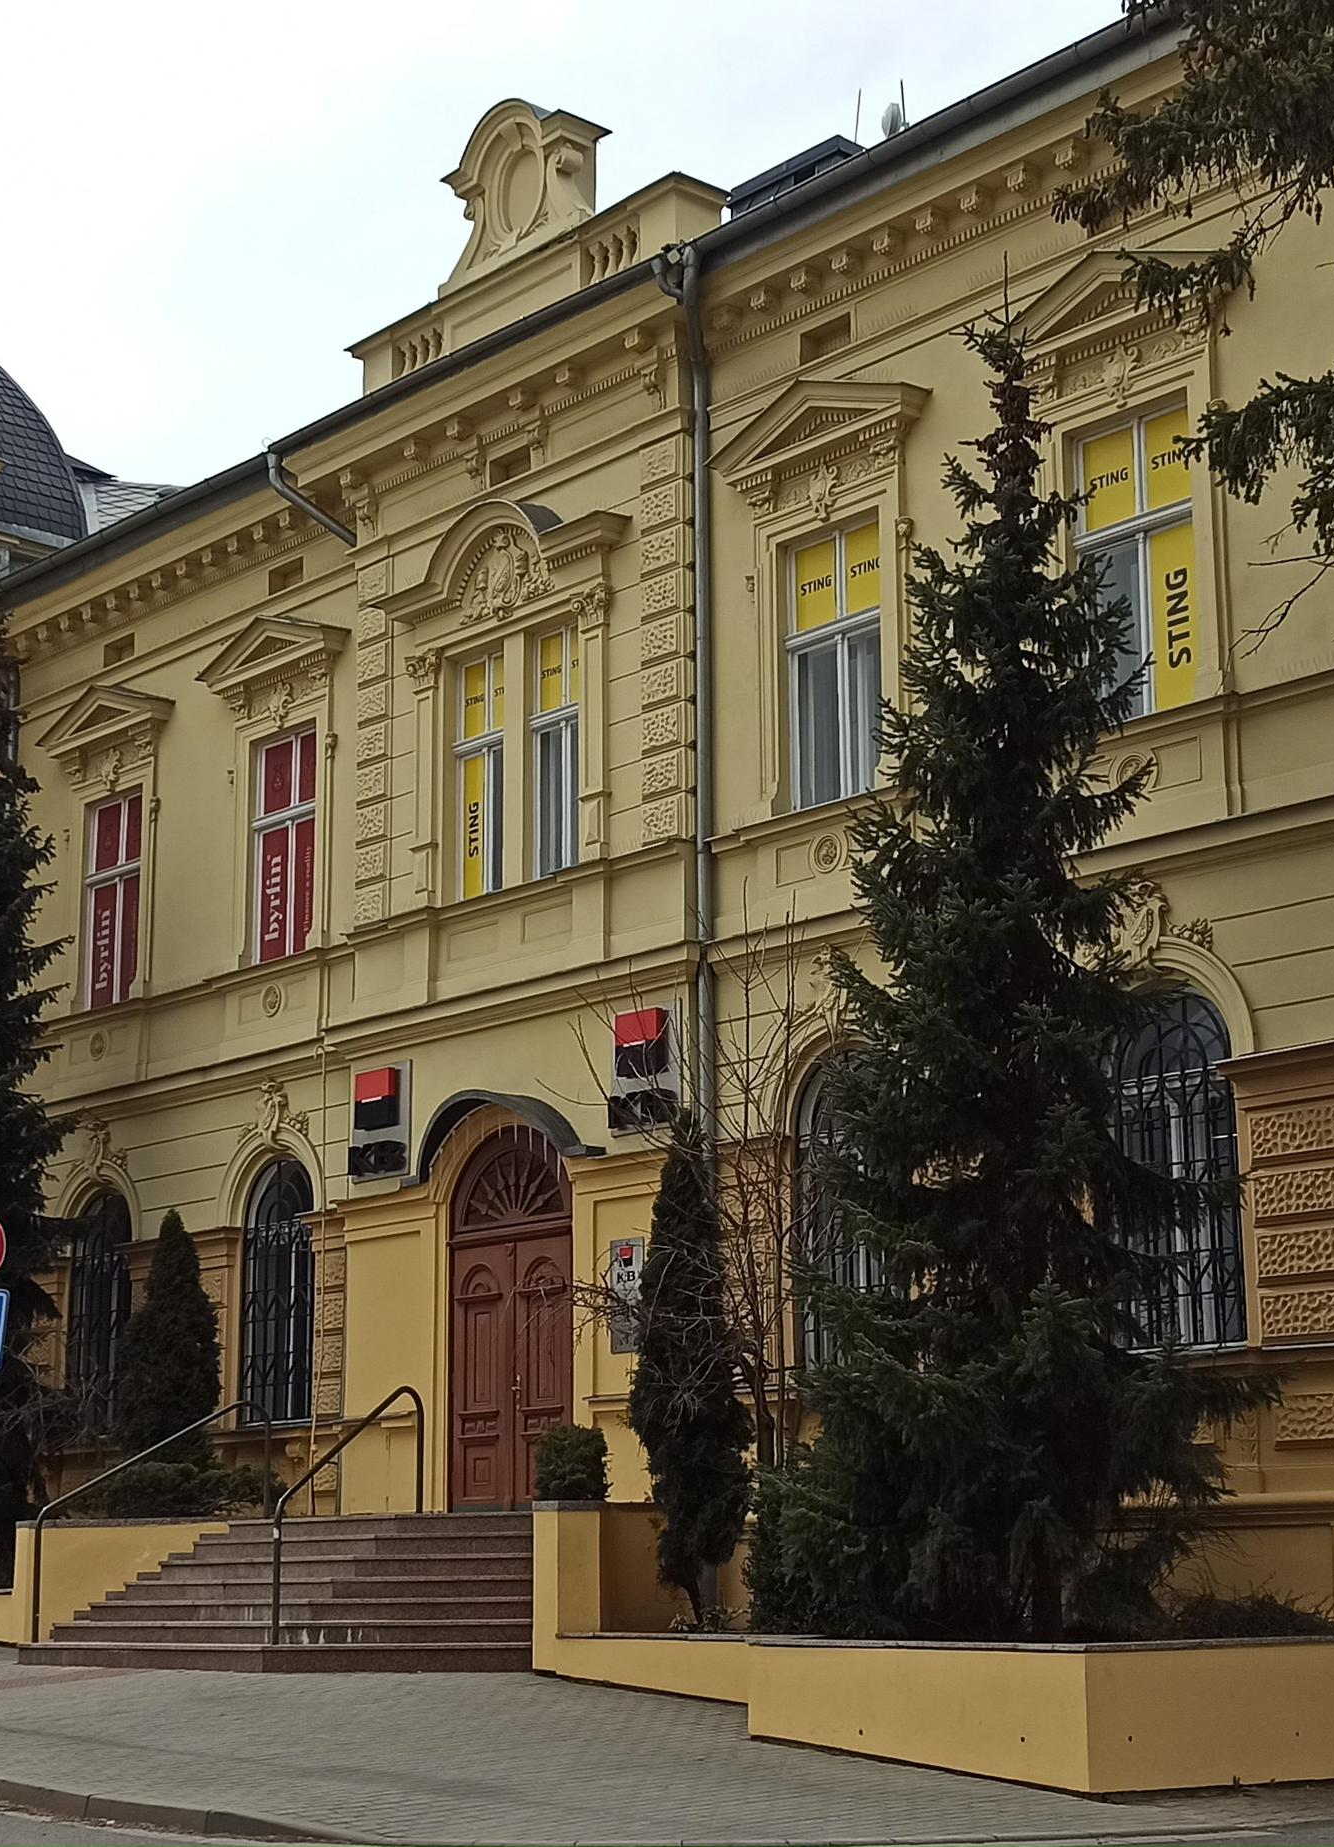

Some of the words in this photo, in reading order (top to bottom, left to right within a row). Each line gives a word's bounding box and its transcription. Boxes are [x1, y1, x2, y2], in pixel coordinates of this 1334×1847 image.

[1089, 467, 1129, 491] STING
[800, 574, 832, 596] STING
[1165, 567, 1192, 669] STING
[541, 664, 563, 680] STING
[494, 686, 504, 698] STI
[468, 801, 479, 858] STING
[264, 855, 283, 941] byrlin
[617, 1270, 636, 1284] KB
